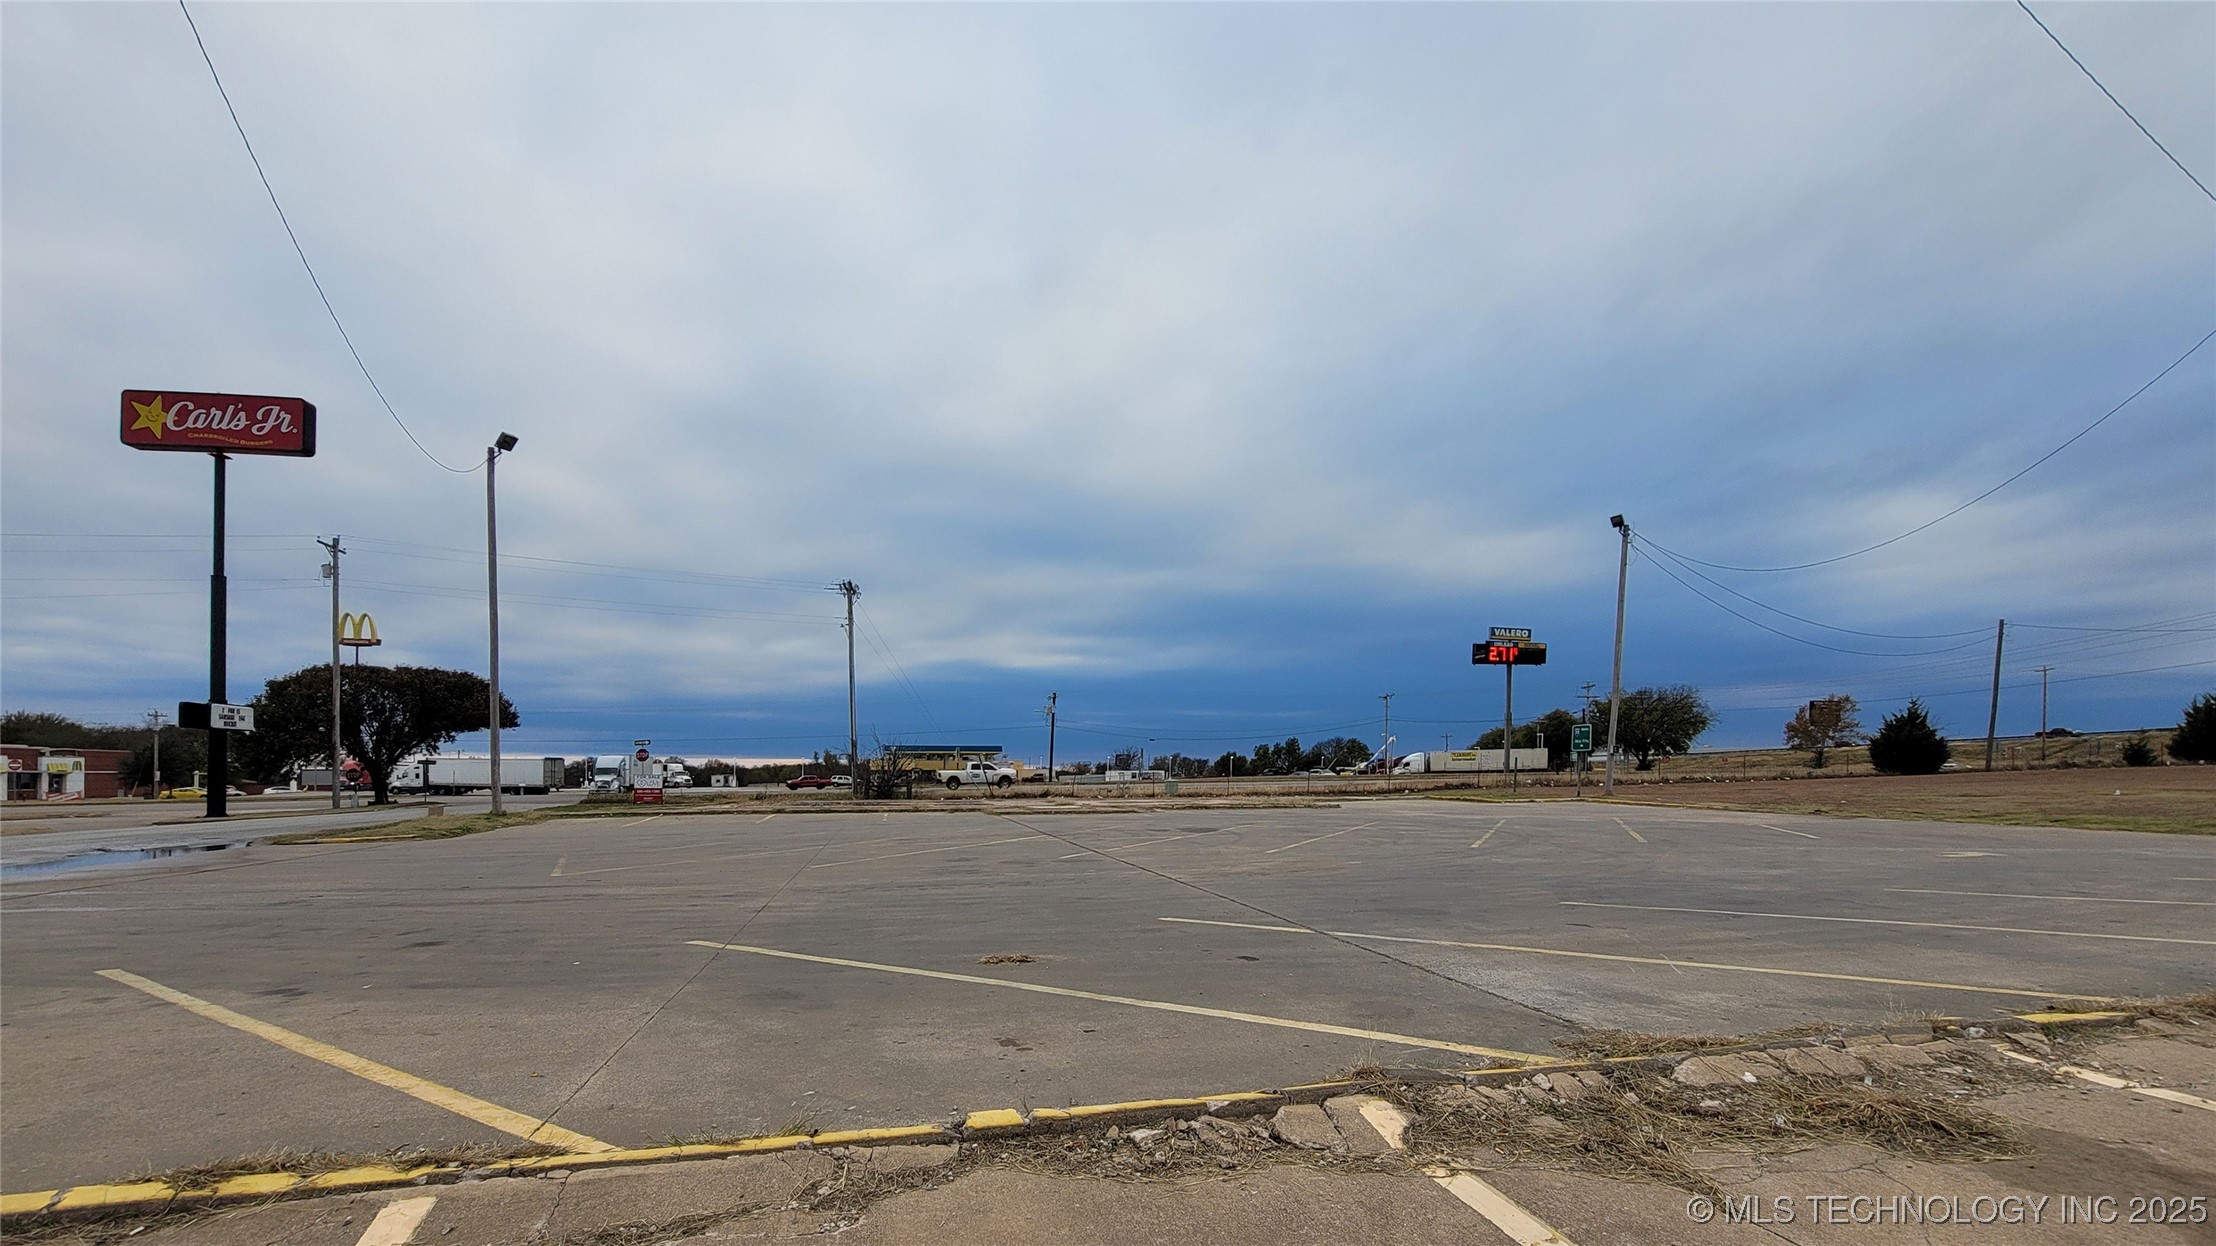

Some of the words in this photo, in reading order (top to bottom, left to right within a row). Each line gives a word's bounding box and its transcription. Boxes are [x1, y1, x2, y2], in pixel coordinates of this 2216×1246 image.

[166, 401, 250, 431] Carl's
[251, 405, 298, 435] Jr.
[1494, 628, 1529, 637] VALERO
